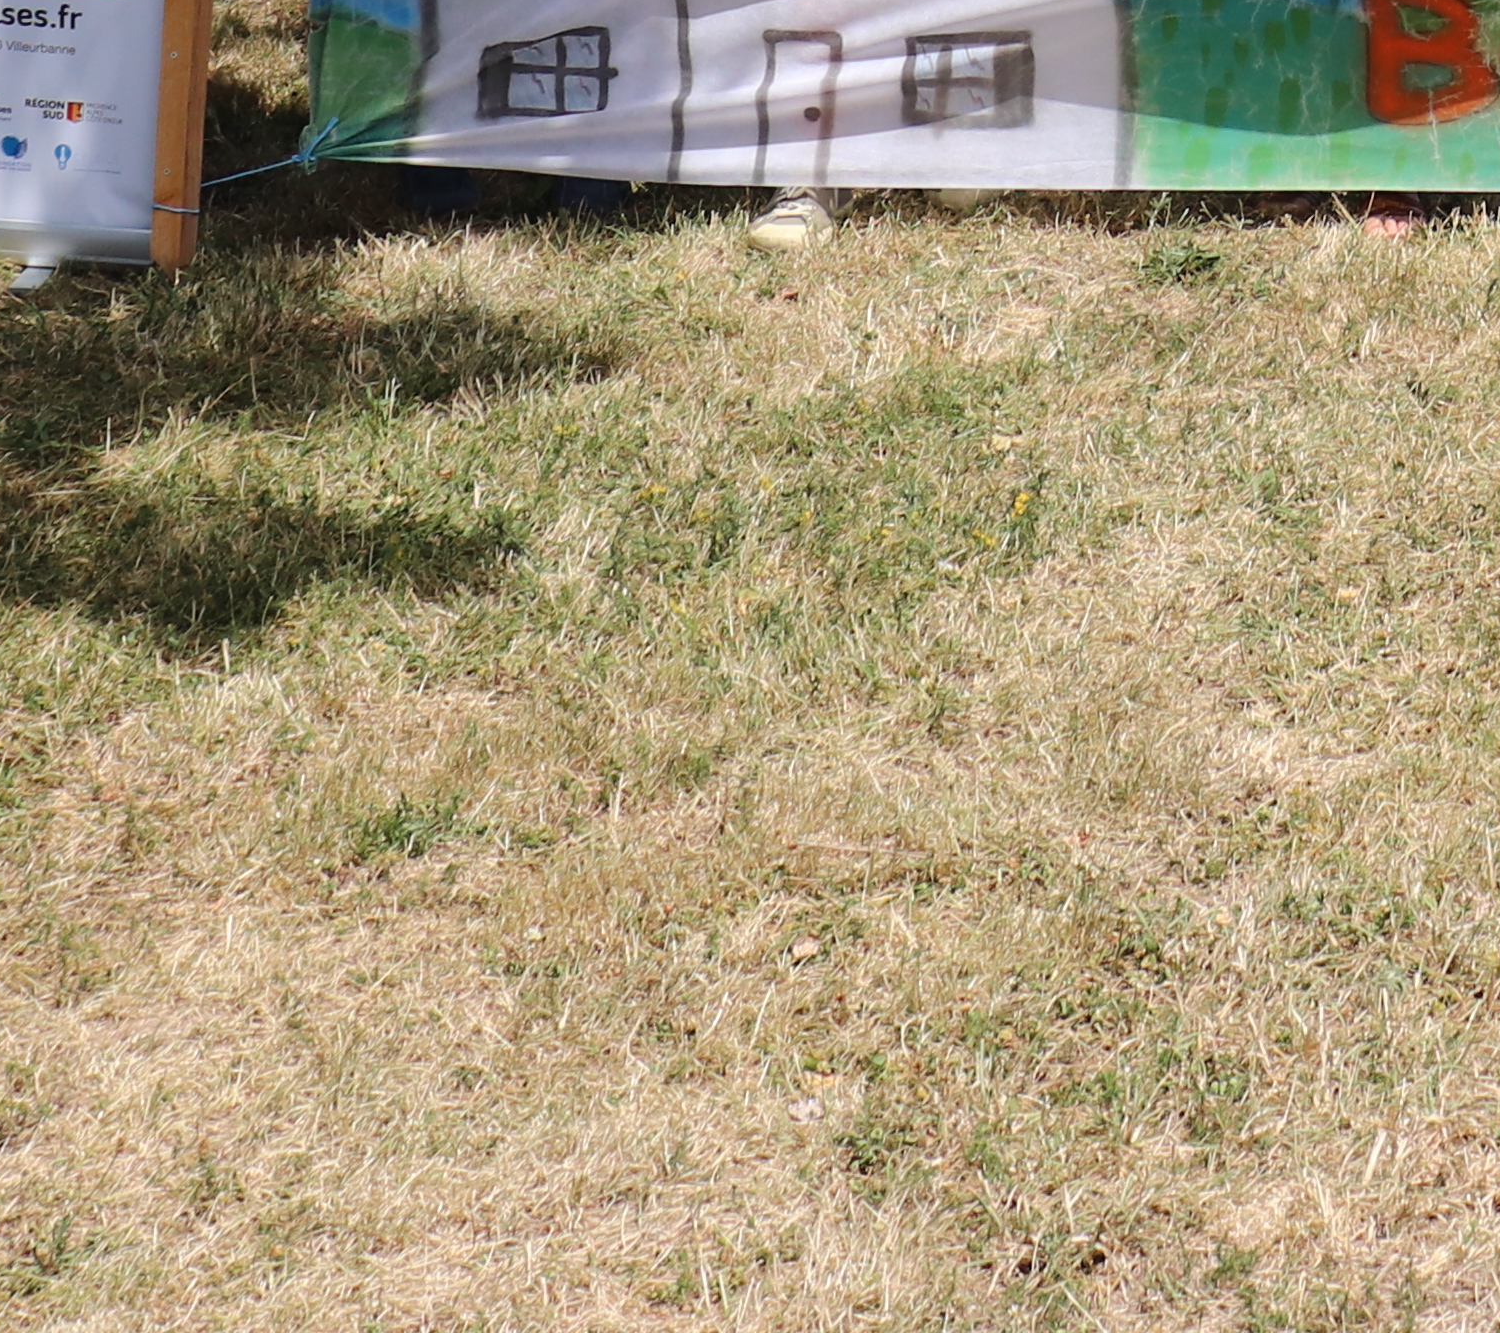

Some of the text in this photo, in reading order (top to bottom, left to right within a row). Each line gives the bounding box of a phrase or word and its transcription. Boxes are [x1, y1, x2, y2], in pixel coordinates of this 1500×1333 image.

[6, 40, 76, 55] Villeurbanne
[25, 97, 65, 110] RÉGION
[42, 110, 64, 120] SUD
